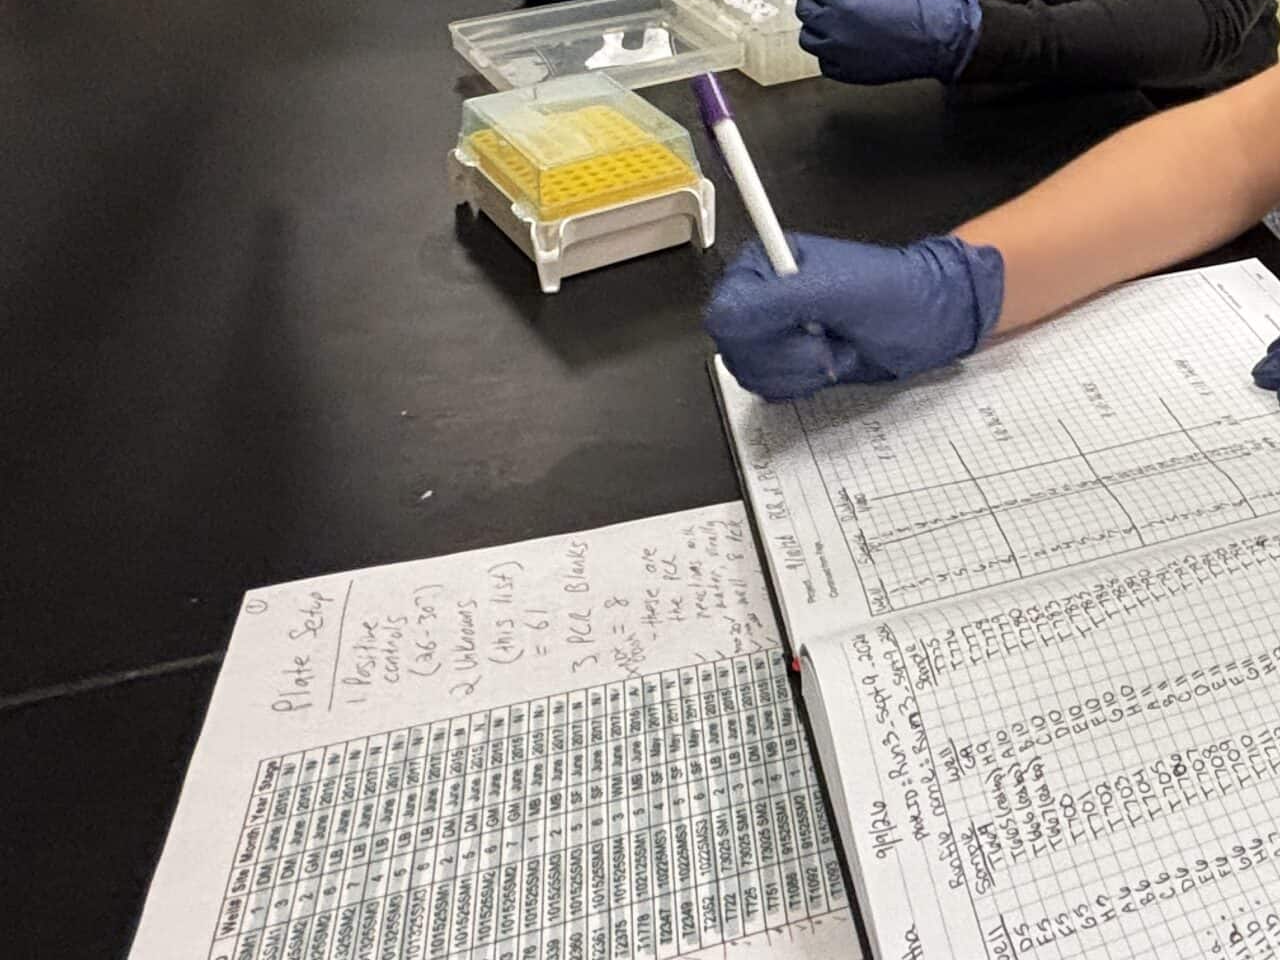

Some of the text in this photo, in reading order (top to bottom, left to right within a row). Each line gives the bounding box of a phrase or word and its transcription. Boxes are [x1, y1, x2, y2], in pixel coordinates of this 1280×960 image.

[522, 609, 549, 631] 61
[562, 540, 599, 674] 3 PCR Blanks
[270, 591, 335, 713] Plate Setup
[340, 621, 379, 686] Positive
[380, 615, 409, 685] controls
[448, 599, 482, 696] 2 Unknowns
[646, 706, 661, 729] 2017
[703, 693, 717, 717] 2015
[1084, 698, 1107, 727] F10
[609, 712, 623, 739] 2017
[708, 722, 720, 745] June
[449, 749, 464, 775] 2015
[511, 736, 524, 761] 2015
[611, 743, 623, 768] June
[709, 755, 723, 771] LB
[1102, 691, 1162, 822] T704 G10
[1120, 685, 1182, 813] T705 H10
[1218, 739, 1251, 789] T709
[1240, 735, 1267, 780] T710
[427, 755, 442, 781] 2017
[511, 768, 524, 793] June
[906, 644, 992, 895] Sample Well Sample
[1030, 715, 1086, 844] T700 C10
[1048, 710, 1105, 840] T701 D10
[1186, 748, 1214, 800] T707
[423, 787, 439, 813] June
[446, 781, 461, 808] June
[1095, 781, 1124, 833] T702
[1114, 776, 1143, 828] T703
[441, 817, 457, 839] DM
[507, 802, 522, 823] GM
[256, 789, 291, 887] DM June 2015
[420, 825, 434, 844] LB
[869, 801, 903, 859] 9/9/26
[220, 760, 281, 936] Well# Site Month Year Stage
[765, 882, 780, 912] T751
[804, 866, 822, 903] T1092
[723, 892, 738, 924] T722
[743, 886, 759, 918] T725
